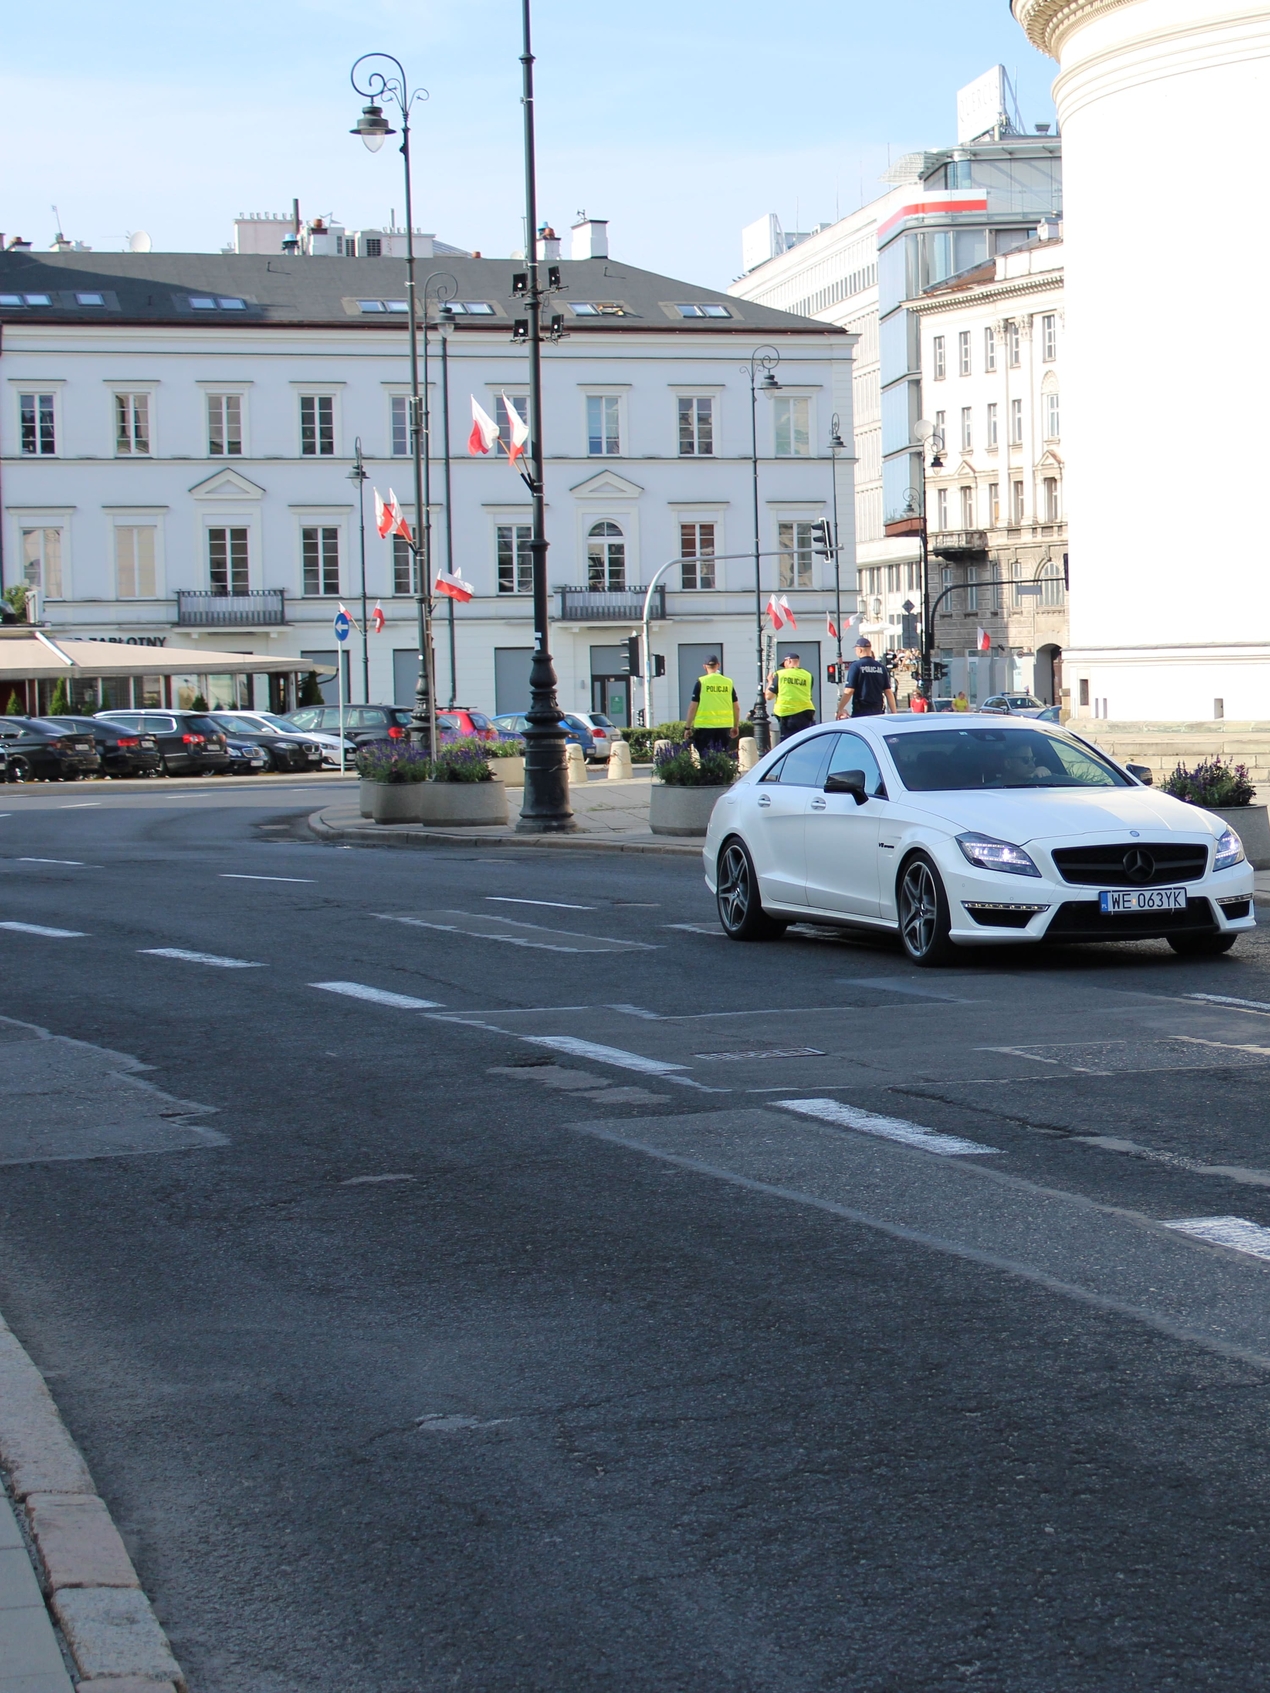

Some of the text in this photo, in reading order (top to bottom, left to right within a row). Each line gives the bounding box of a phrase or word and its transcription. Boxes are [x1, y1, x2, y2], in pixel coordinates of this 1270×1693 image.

[860, 665, 883, 675] POLICJA
[783, 677, 807, 687] POLICJA
[706, 685, 729, 693] POLICJA
[1111, 891, 1182, 910] WE 063YK
